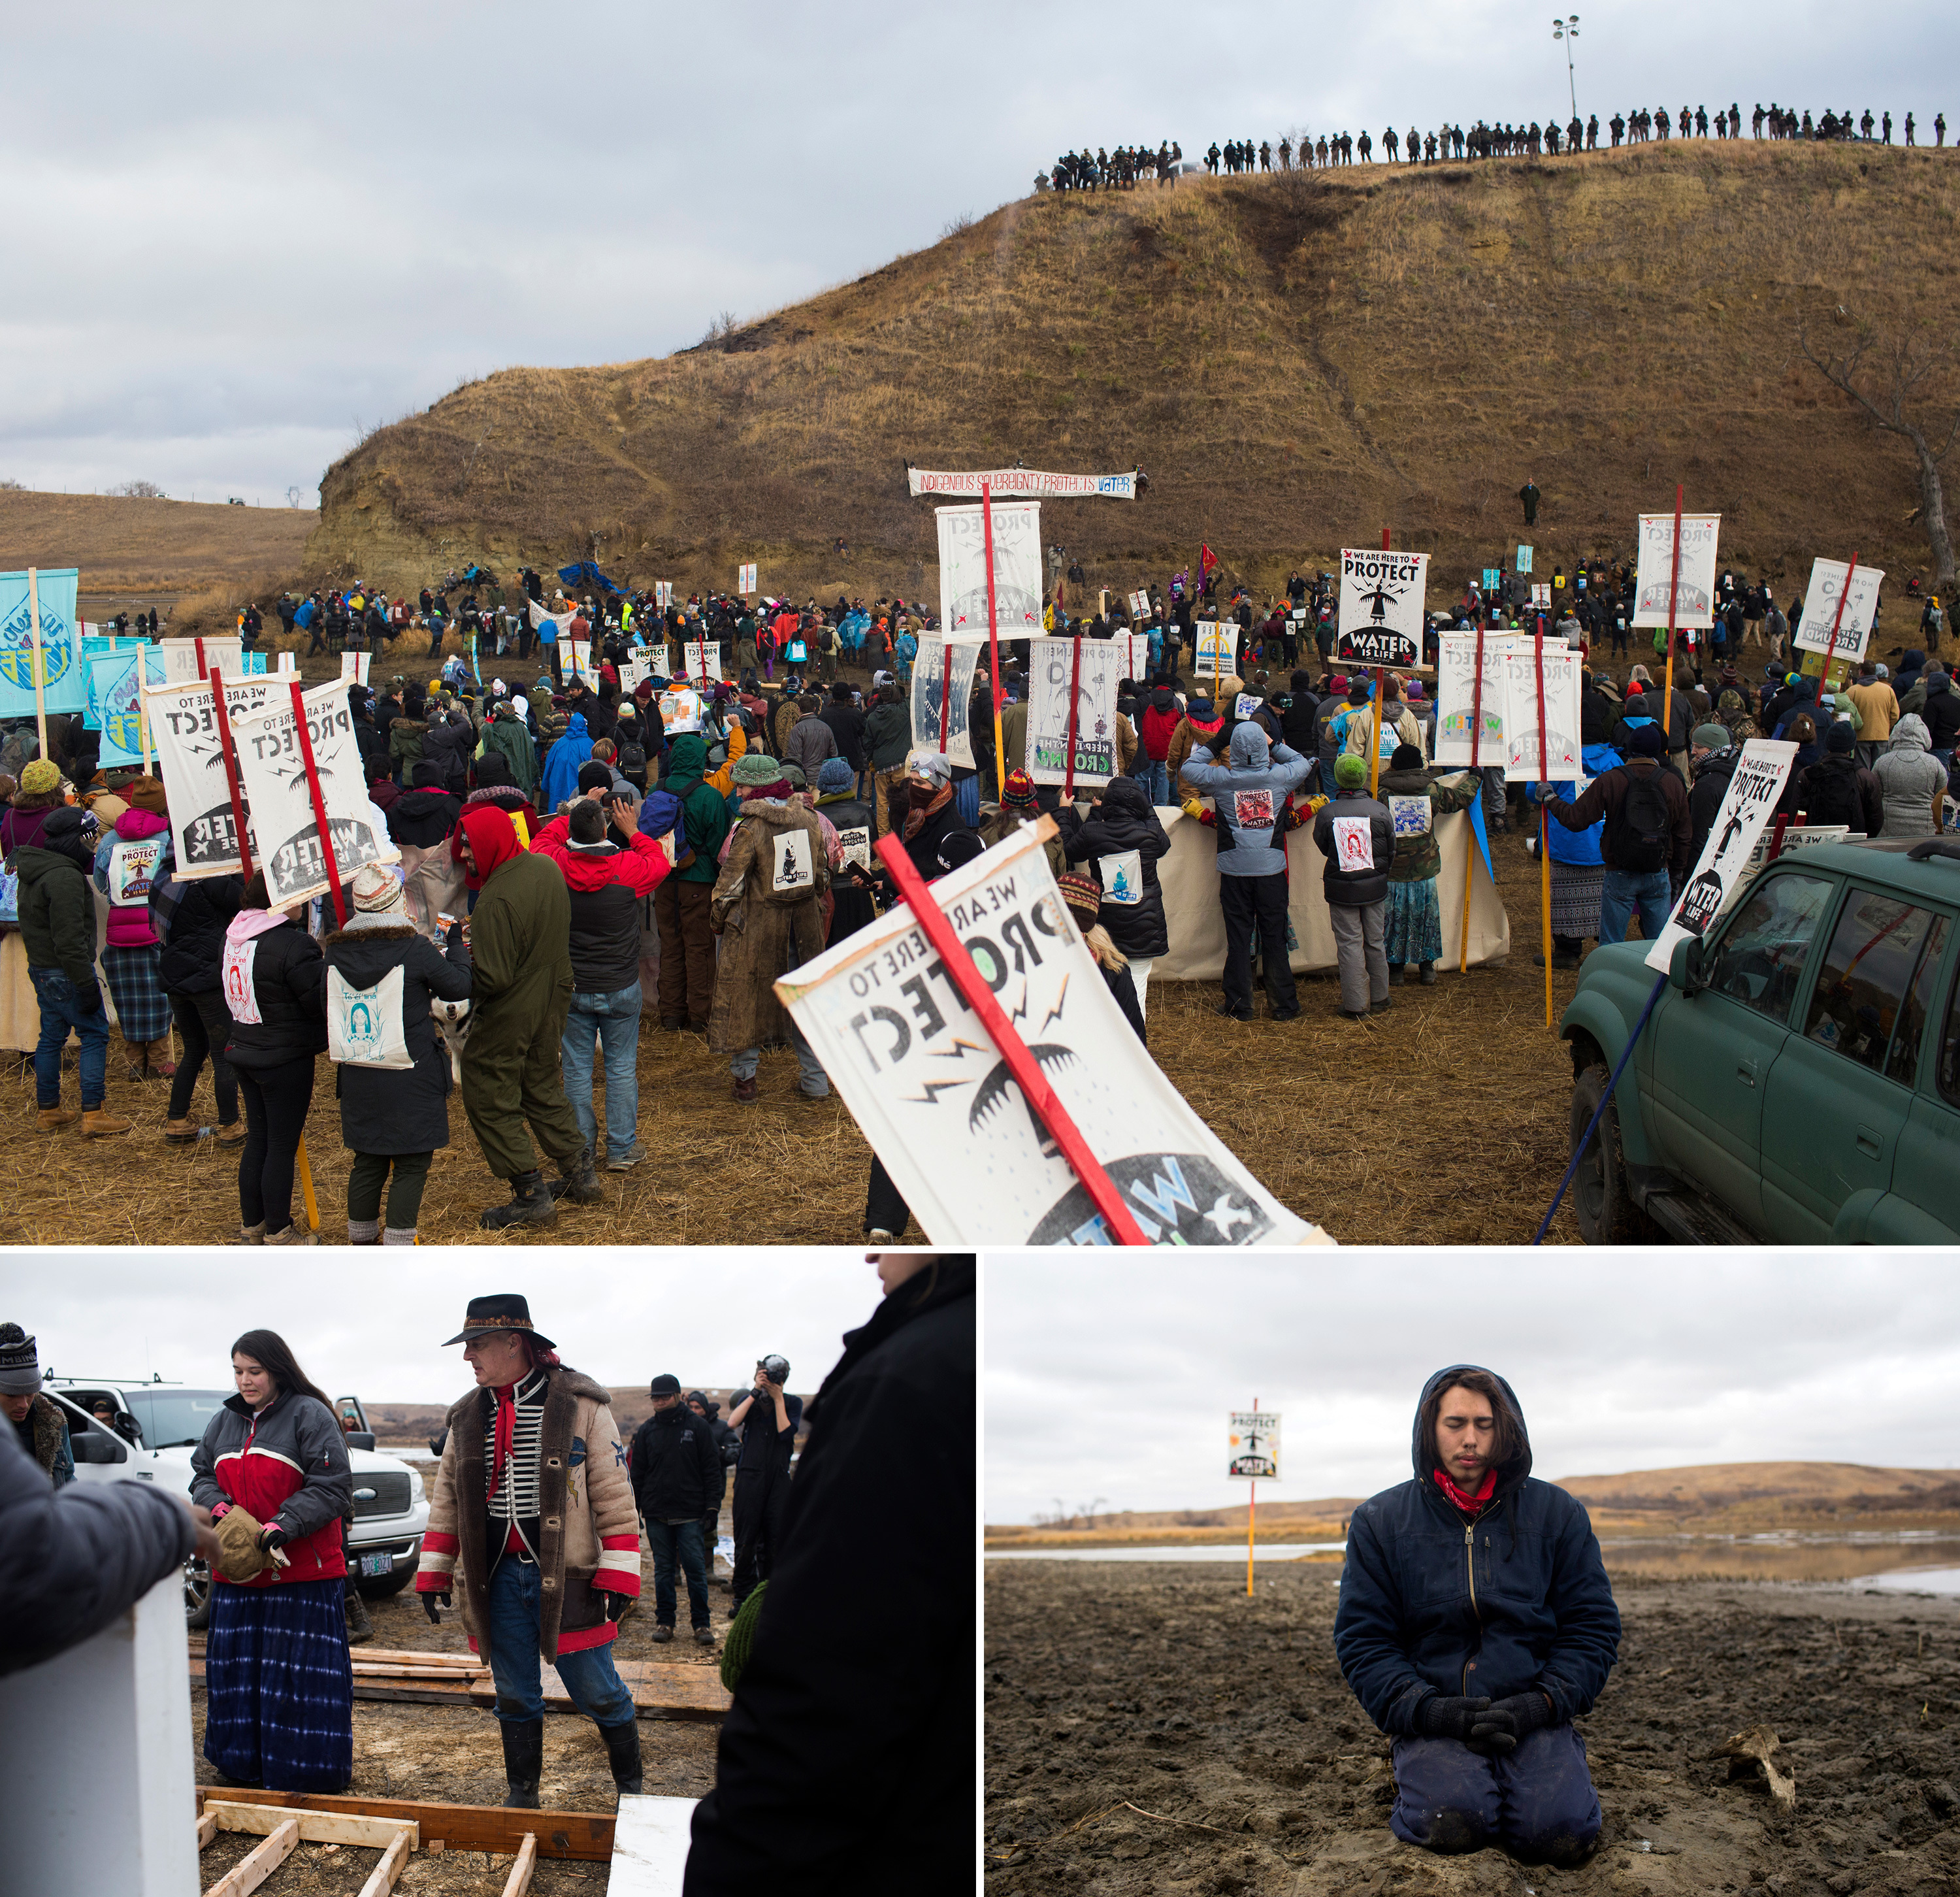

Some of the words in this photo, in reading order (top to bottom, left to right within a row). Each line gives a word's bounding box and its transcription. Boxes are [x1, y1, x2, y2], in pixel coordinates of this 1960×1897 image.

[920, 474, 974, 491] INDIGENOUS
[1098, 476, 1130, 492] WATER
[1381, 553, 1398, 563] HERE
[1345, 559, 1418, 582] PROTECT
[1350, 633, 1411, 653] WATER
[636, 649, 665, 657] PROTECT
[1362, 648, 1371, 657] IS
[1373, 650, 1395, 659] LIFE
[1731, 770, 1777, 802] PROTECT
[1240, 791, 1269, 800] PROTECT
[122, 850, 158, 861] PROTECT
[776, 874, 792, 883] WATER
[127, 882, 152, 892] WATE
[1232, 1418, 1276, 1428] PROTECT
[362, 1559, 374, 1572] 202
